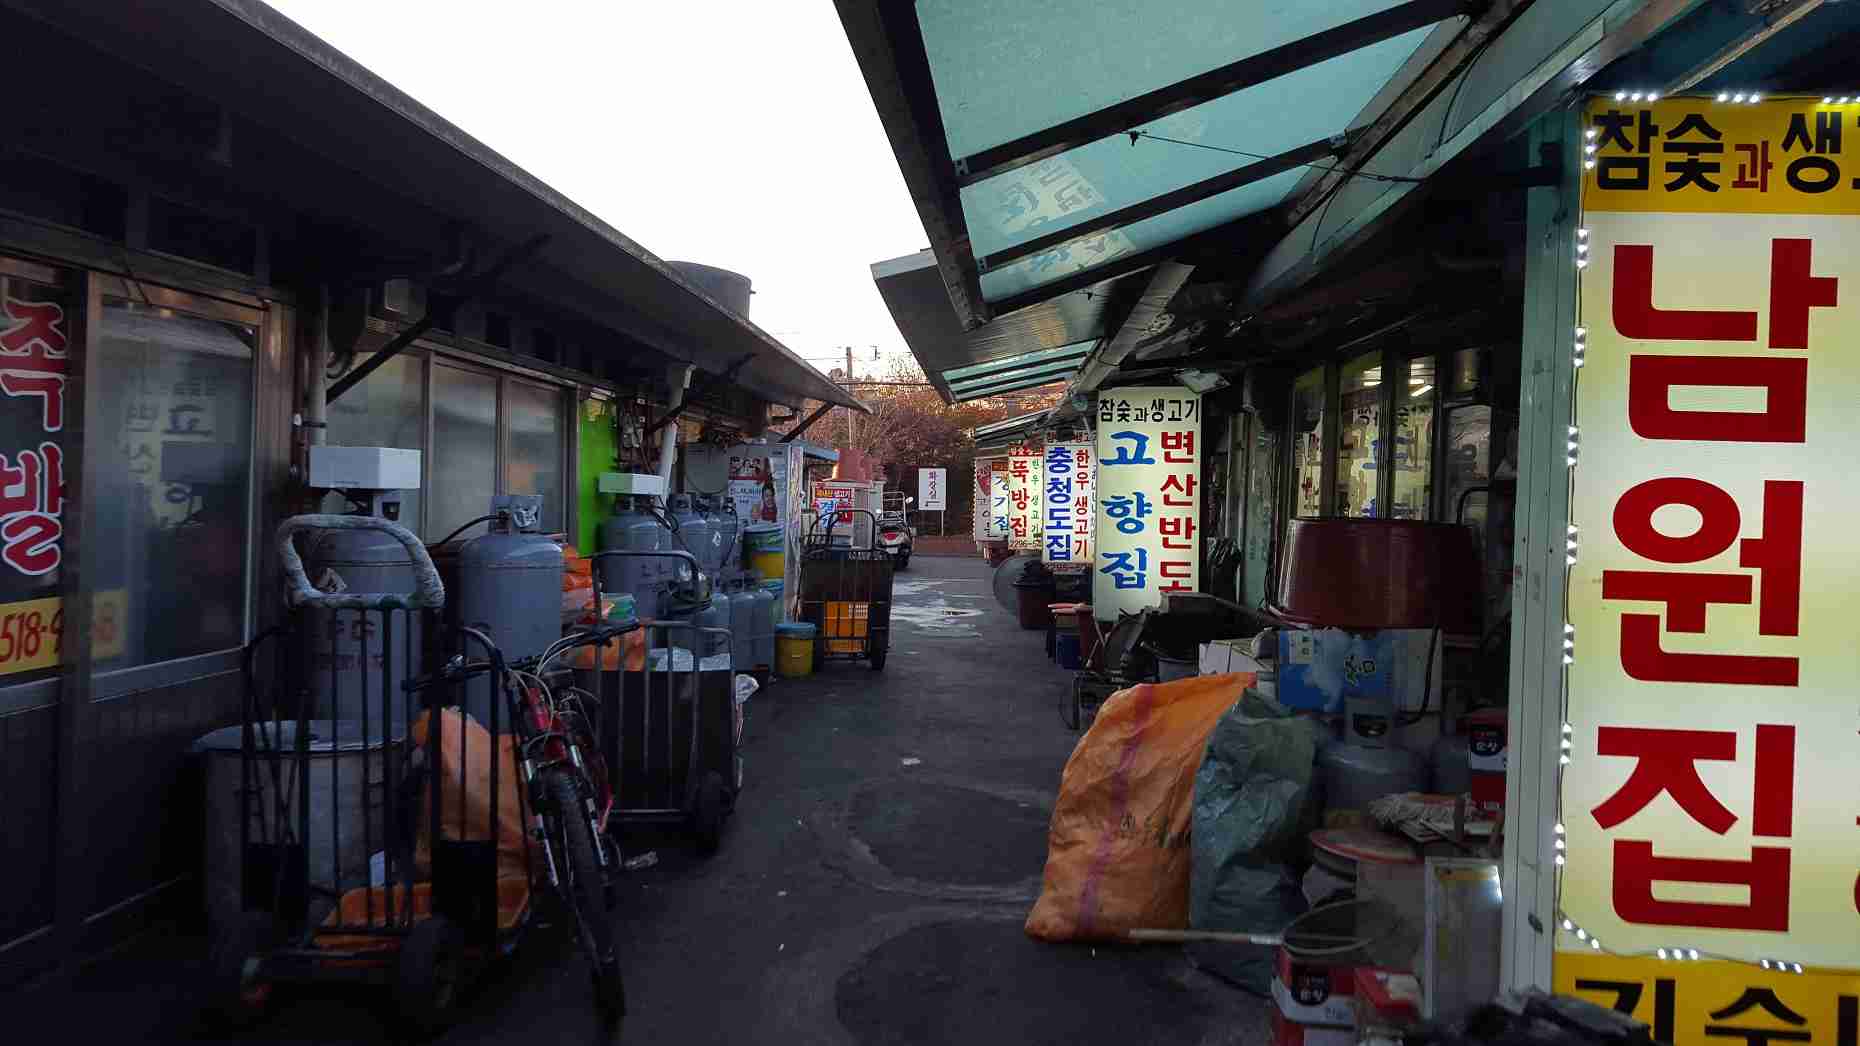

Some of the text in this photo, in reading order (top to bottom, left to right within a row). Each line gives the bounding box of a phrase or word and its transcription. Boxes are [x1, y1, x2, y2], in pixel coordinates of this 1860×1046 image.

[1593, 110, 1860, 194] 참숯과생
[1009, 460, 1030, 538] 뚝방집
[1045, 446, 1074, 561] 충청도집
[1099, 430, 1156, 590] 고향집
[1158, 430, 1198, 593] 변산반도
[1590, 237, 1839, 933] 남원집
